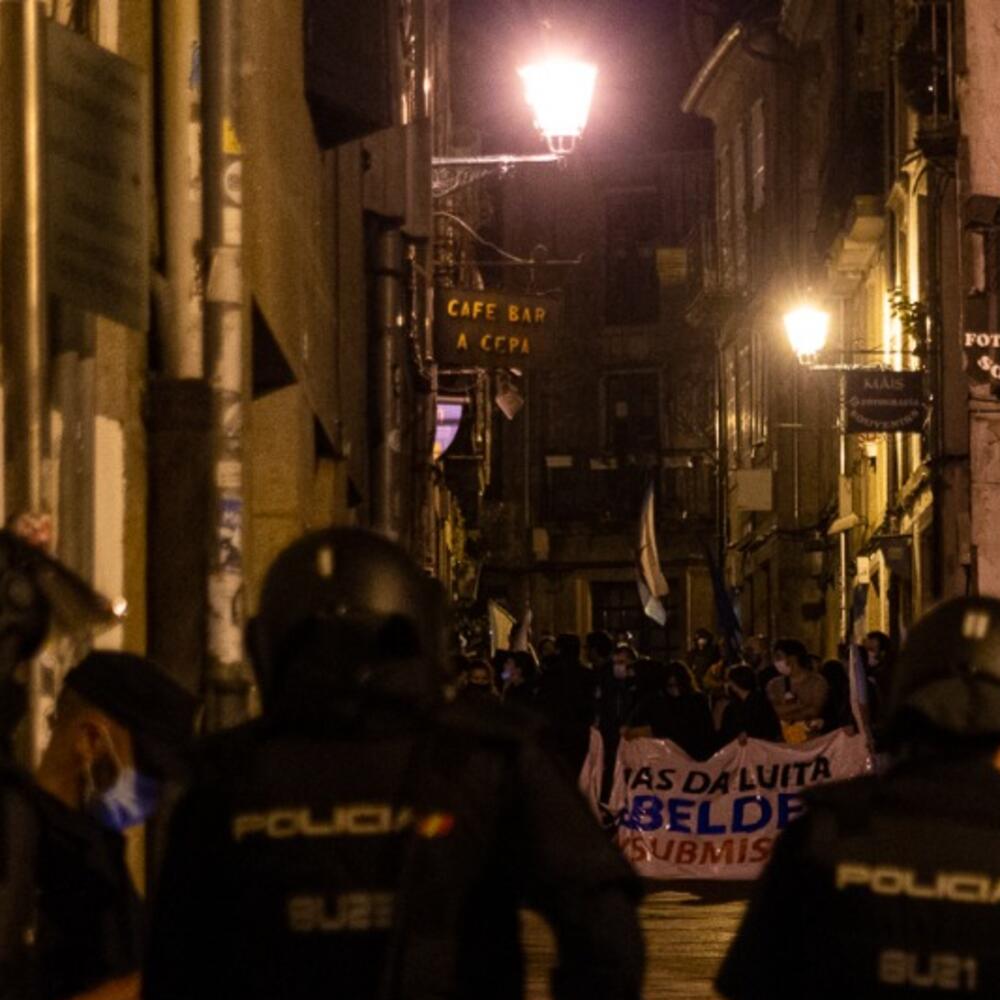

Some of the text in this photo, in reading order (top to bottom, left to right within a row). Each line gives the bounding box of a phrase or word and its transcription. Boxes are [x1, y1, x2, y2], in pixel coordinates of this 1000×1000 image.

[507, 303, 546, 324] BAR
[456, 332, 531, 355] A CEPA
[682, 768, 730, 794] DA
[739, 756, 831, 791] LUITA
[618, 793, 806, 835] BELDE
[617, 837, 771, 866] SUBMIS
